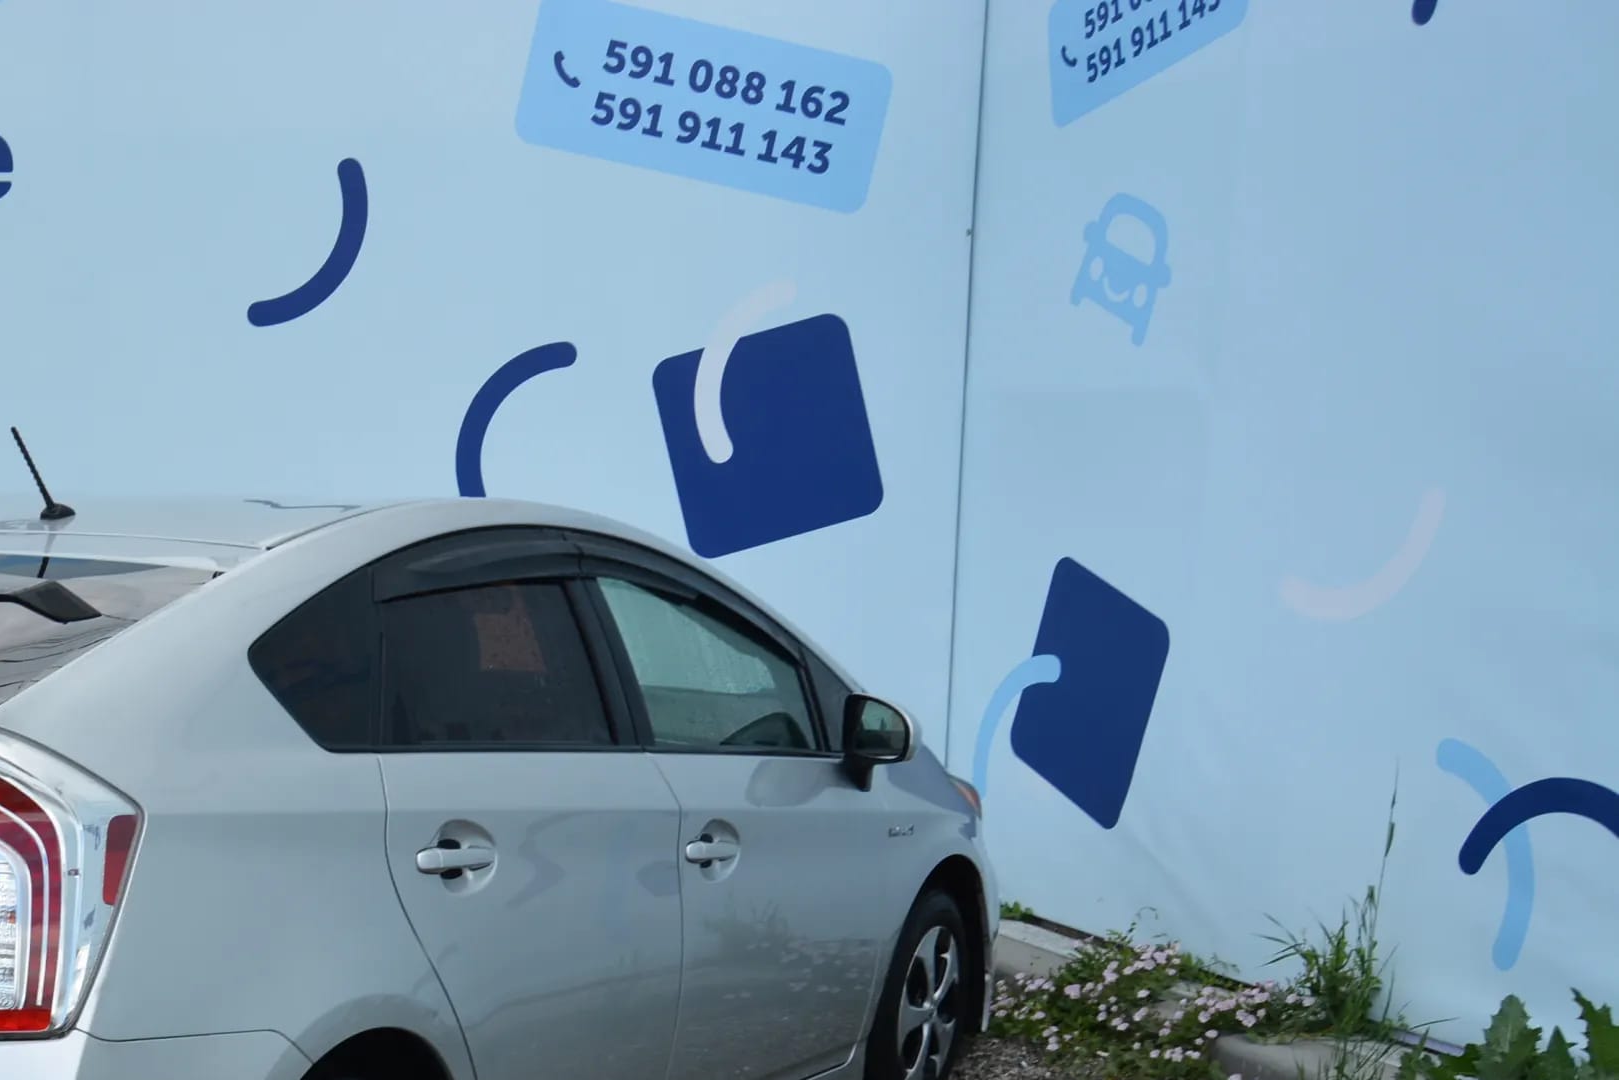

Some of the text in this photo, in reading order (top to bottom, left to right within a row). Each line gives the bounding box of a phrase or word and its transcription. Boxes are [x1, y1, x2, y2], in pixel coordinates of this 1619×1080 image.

[1084, 0, 1124, 39] 591
[1086, 37, 1126, 84] 591
[1131, 9, 1173, 58] 911
[602, 39, 851, 126] 591 088 162
[590, 91, 834, 175] 591 911 143
